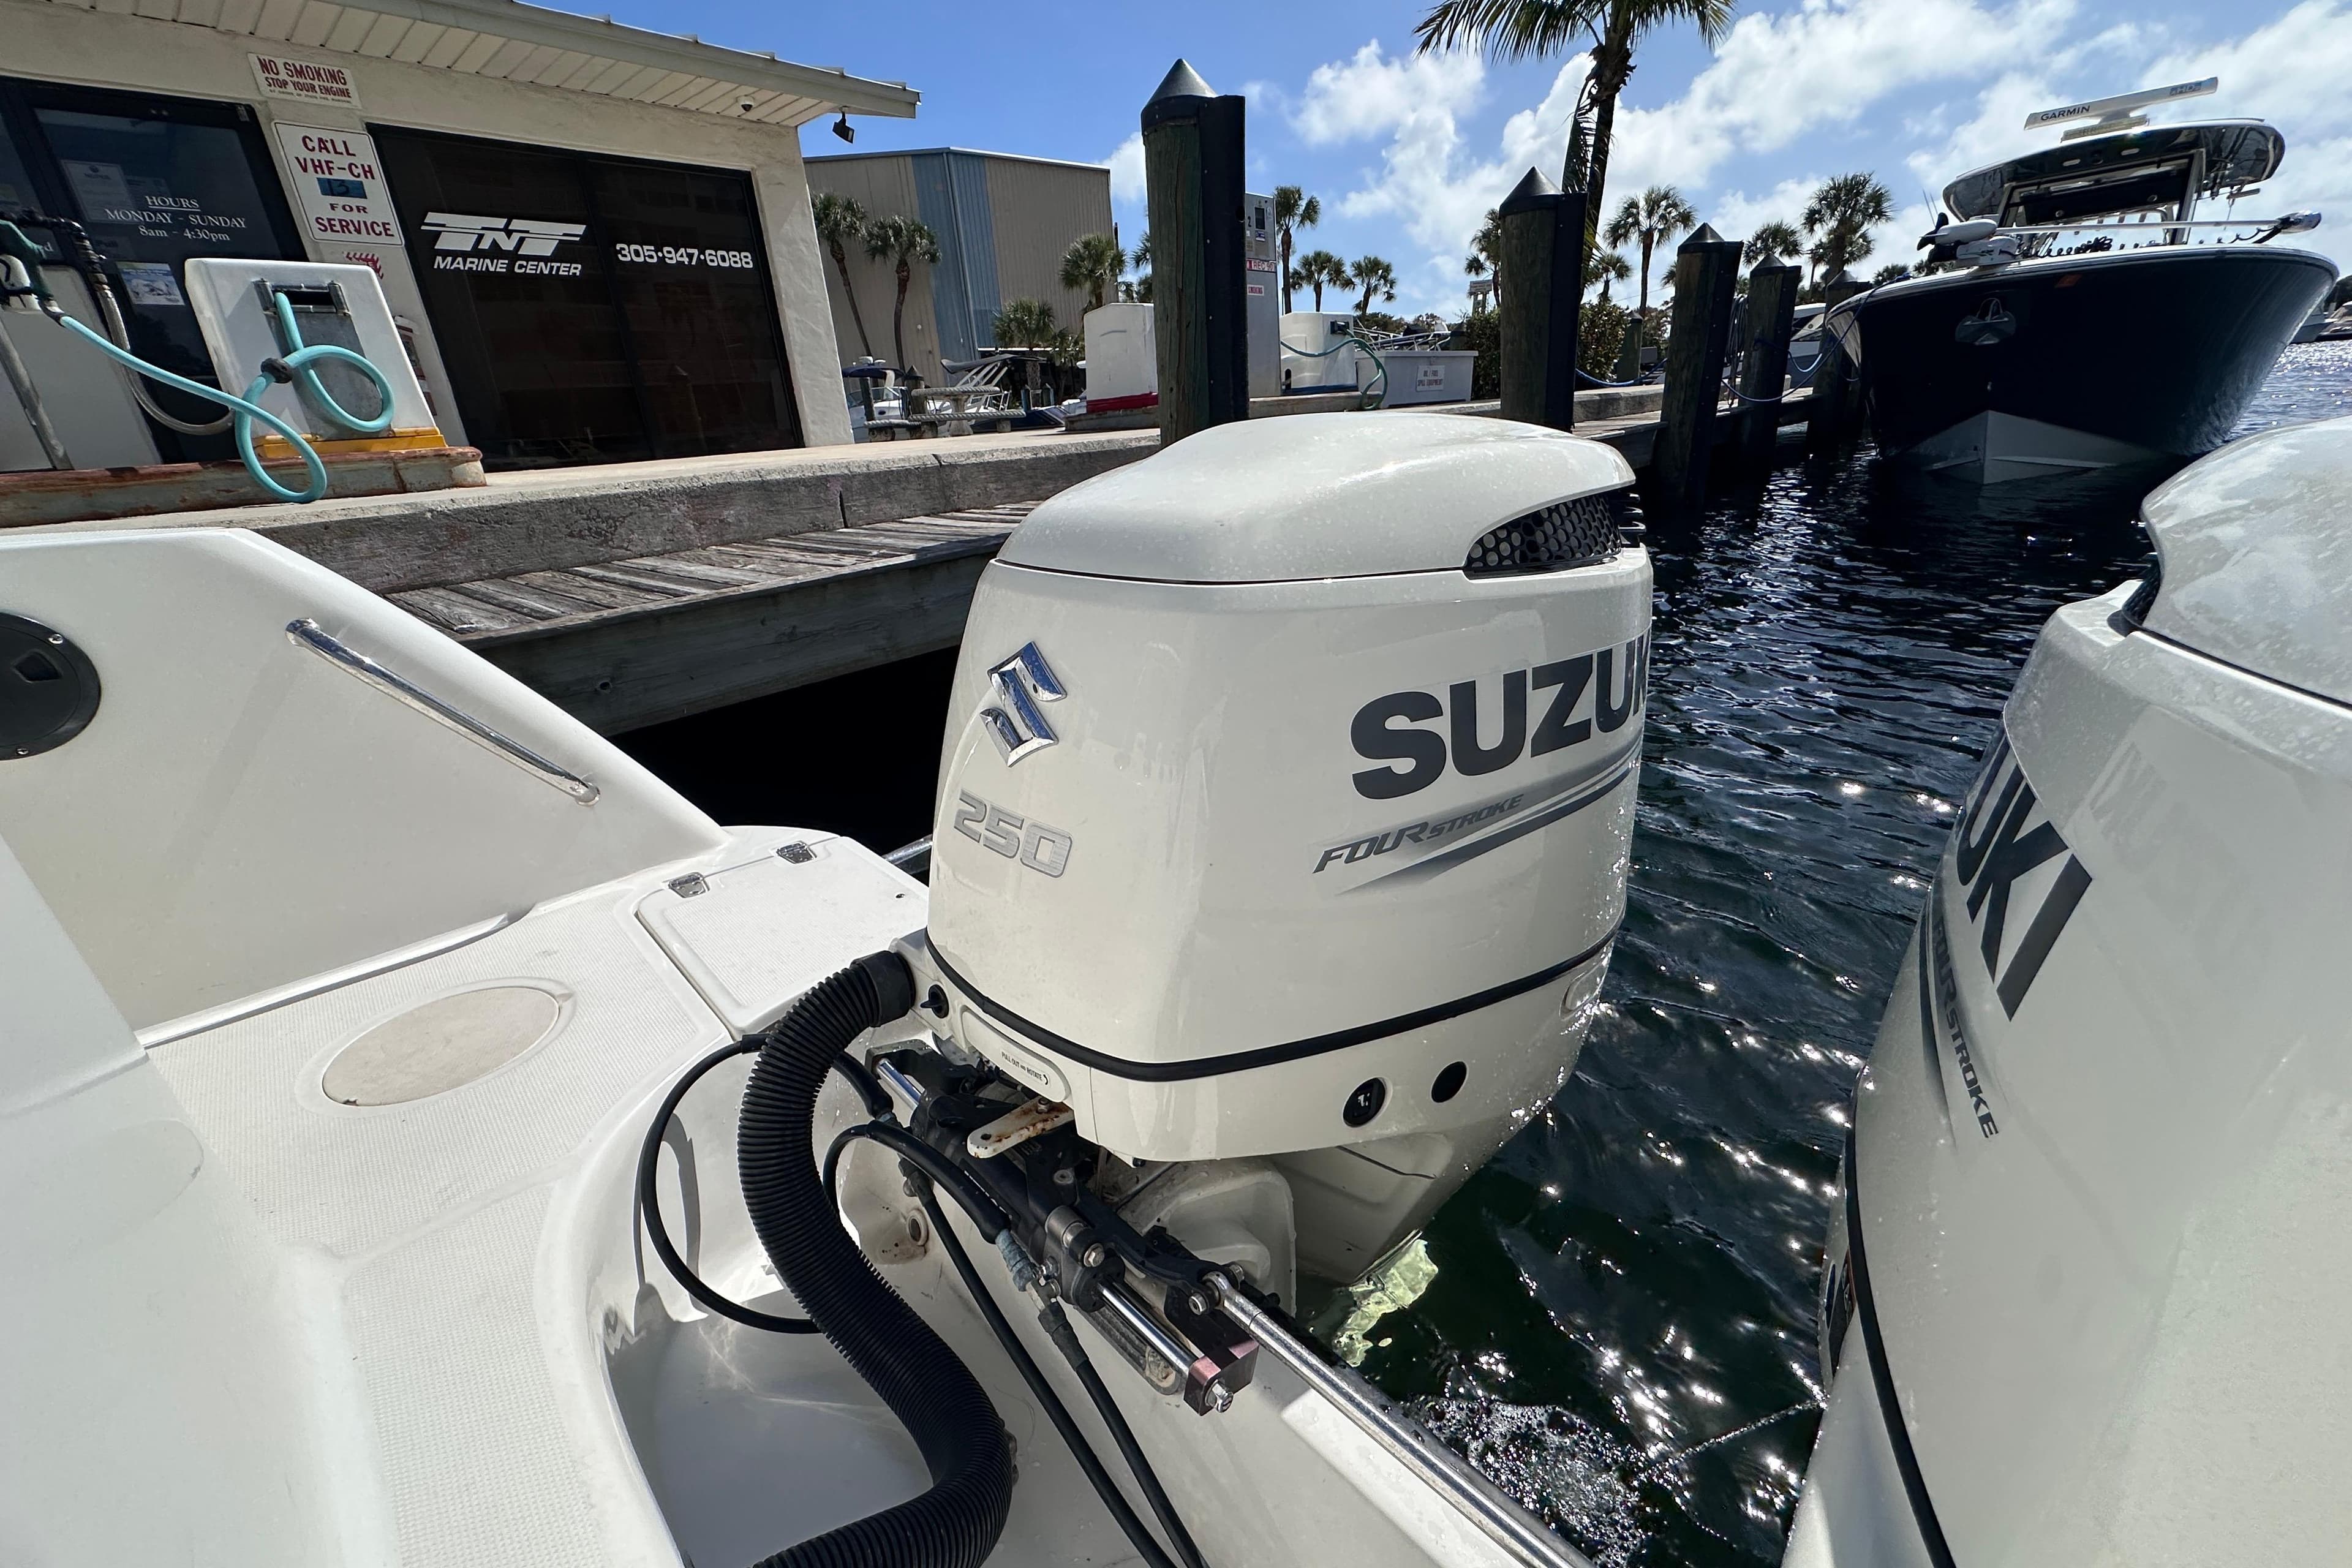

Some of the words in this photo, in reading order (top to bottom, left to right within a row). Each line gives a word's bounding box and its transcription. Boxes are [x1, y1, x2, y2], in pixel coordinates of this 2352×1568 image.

[257, 56, 279, 76] NO
[284, 62, 347, 86] SMOKING
[265, 77, 288, 89] STOP
[290, 80, 317, 93] YOUR
[318, 85, 352, 98] ENGINE
[2041, 105, 2090, 121] GARMIN
[301, 135, 356, 157] CALL
[295, 156, 375, 179] VHF-CH
[145, 196, 199, 209] HOURS
[330, 203, 368, 214] FOR
[105, 208, 173, 224] MONDAY
[189, 215, 247, 228] SUNDAY
[315, 217, 394, 237] SERVICE
[138, 225, 168, 238] 8am
[184, 228, 231, 243] 4:30pm
[420, 212, 587, 256] TNT
[434, 256, 508, 273] MARINE
[514, 260, 582, 276] CENTER
[1253, 261, 1265, 270] REC
[1350, 628, 1650, 799] SUZUK
[954, 788, 1073, 878] 250
[1956, 736, 2093, 1022] UKI
[1001, 1051, 1011, 1063] PULL
[1027, 1067, 1042, 1081] ROTATE
